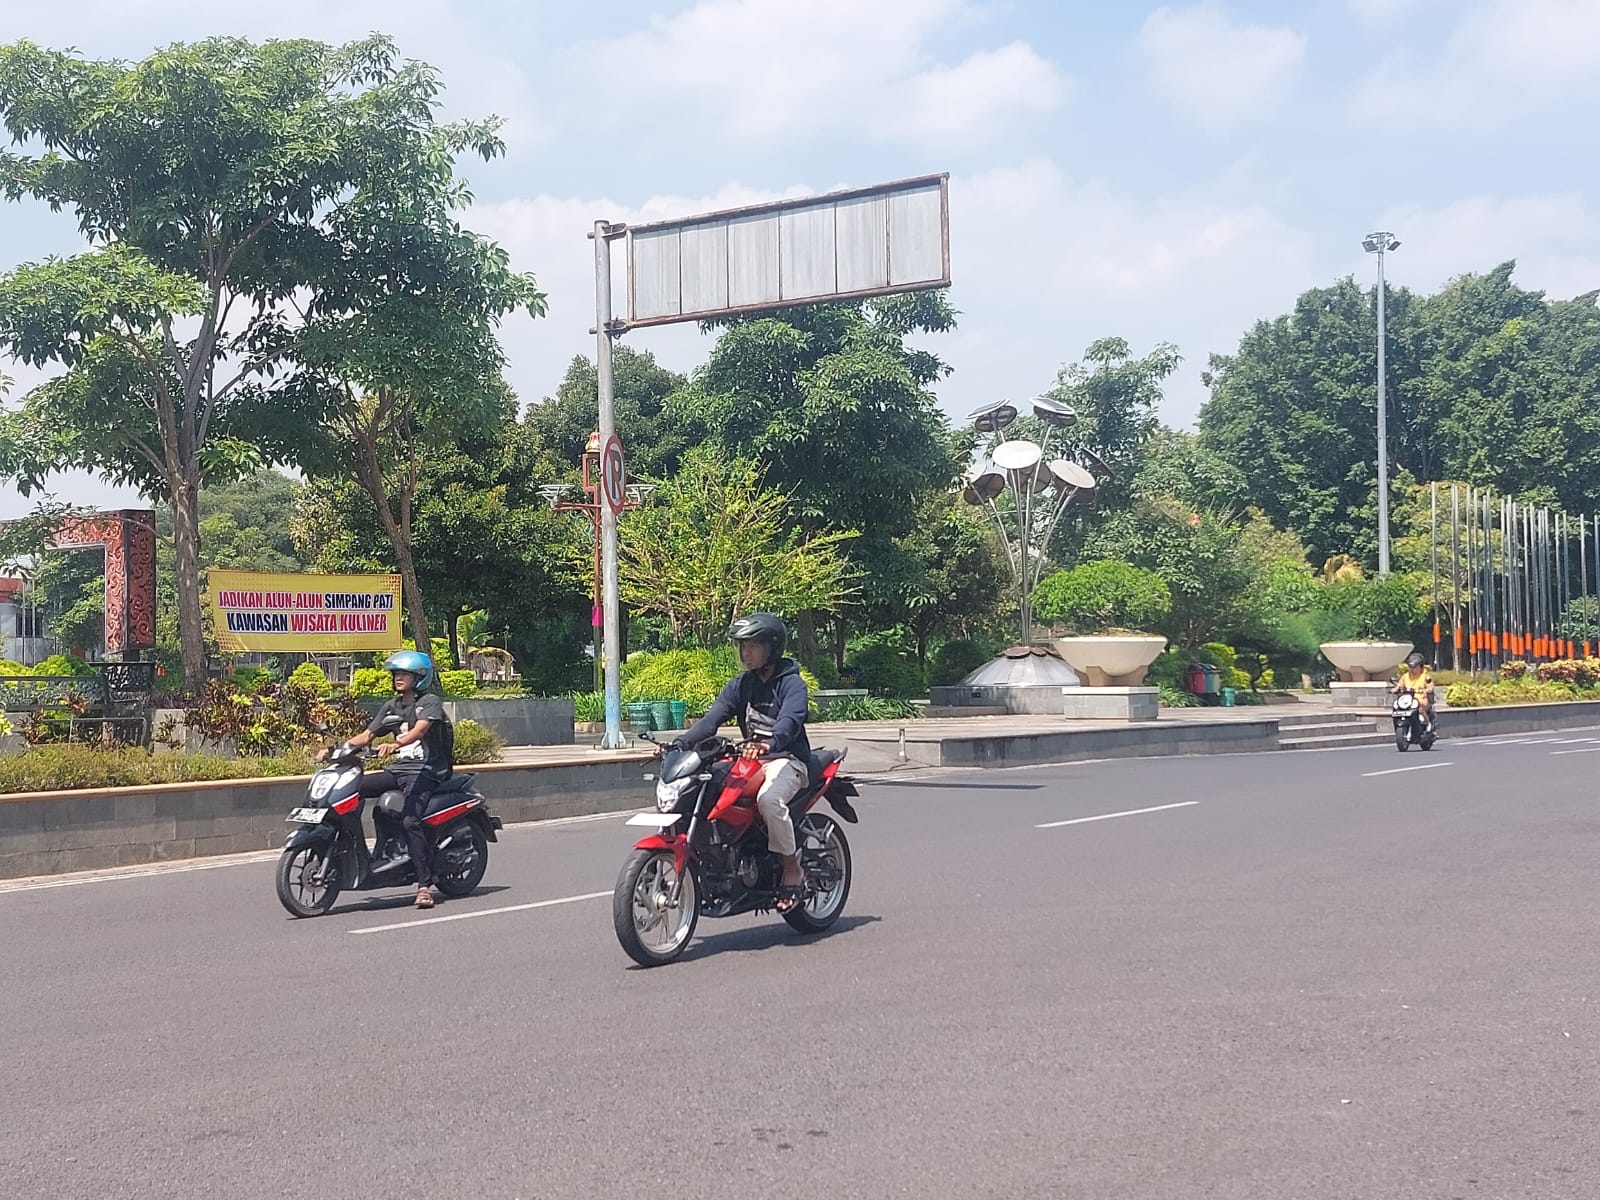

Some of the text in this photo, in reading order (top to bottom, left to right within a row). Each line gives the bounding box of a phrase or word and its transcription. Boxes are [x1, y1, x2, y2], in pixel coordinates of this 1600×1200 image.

[218, 591, 394, 609] JADIKAN ALUN-ALUN SIMPANG PATI
[226, 612, 387, 632] KAWASAN WISATA KULINER
